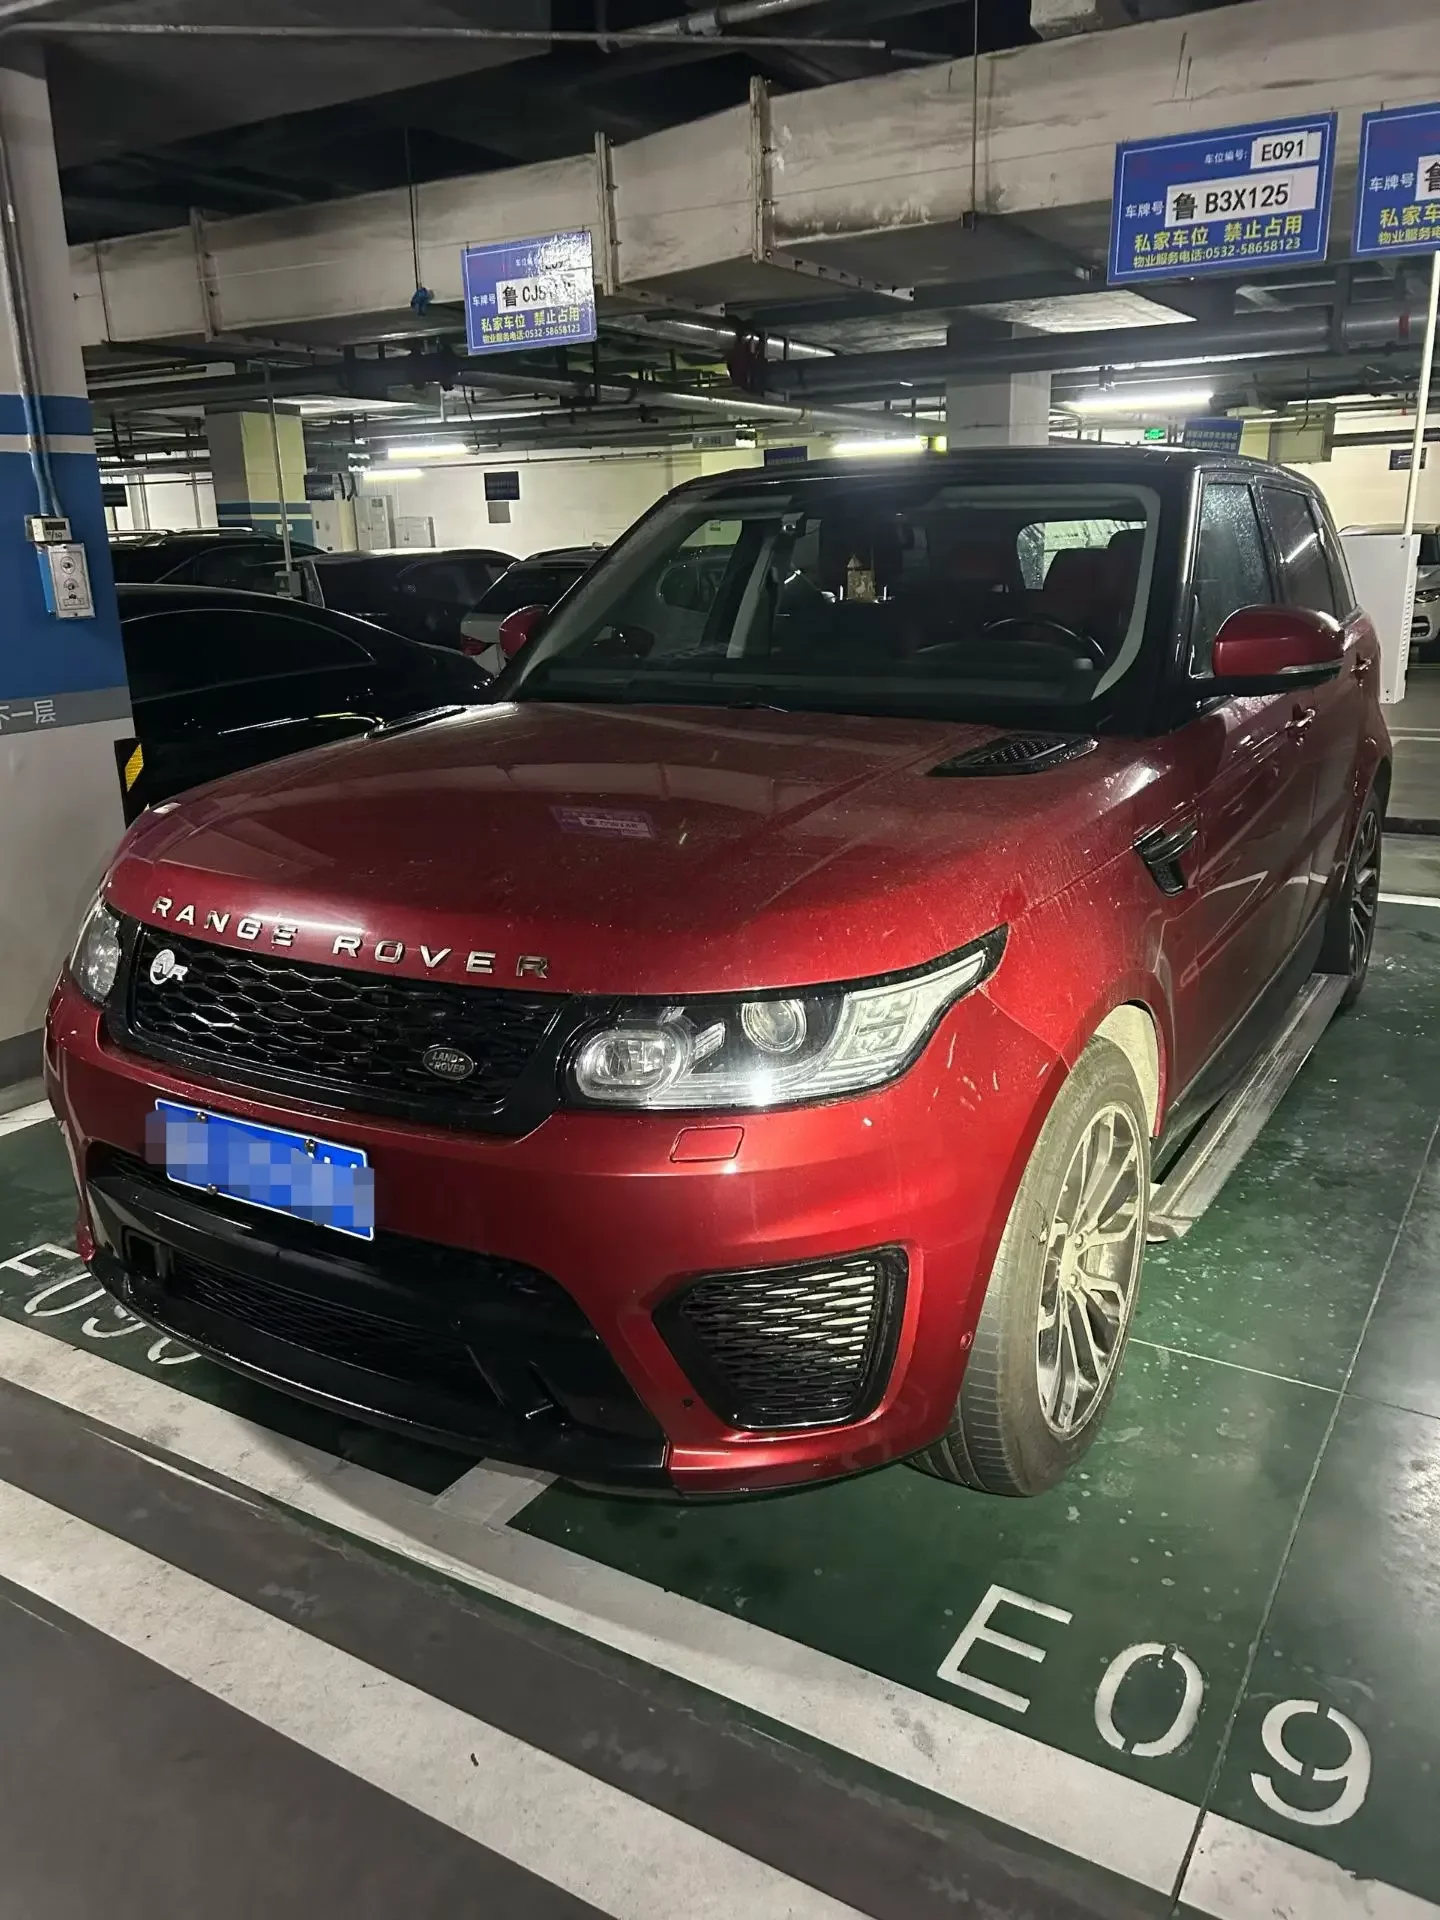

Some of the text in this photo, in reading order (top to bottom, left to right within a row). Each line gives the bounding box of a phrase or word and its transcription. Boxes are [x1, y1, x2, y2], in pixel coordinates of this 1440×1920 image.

[1261, 139, 1304, 161] E091
[1369, 172, 1415, 192] 车牌号
[1125, 183, 1289, 221] 车牌号 鲁 B3X125
[1135, 215, 1303, 253] 私家车位 禁止占用
[502, 286, 518, 307] 鲁
[481, 306, 580, 333] 私家车位 禁止占用
[152, 896, 549, 979] RANGE ROVER
[432, 1051, 458, 1063] LAND
[434, 1061, 466, 1073] ROVER
[937, 1584, 1372, 1826] E09
